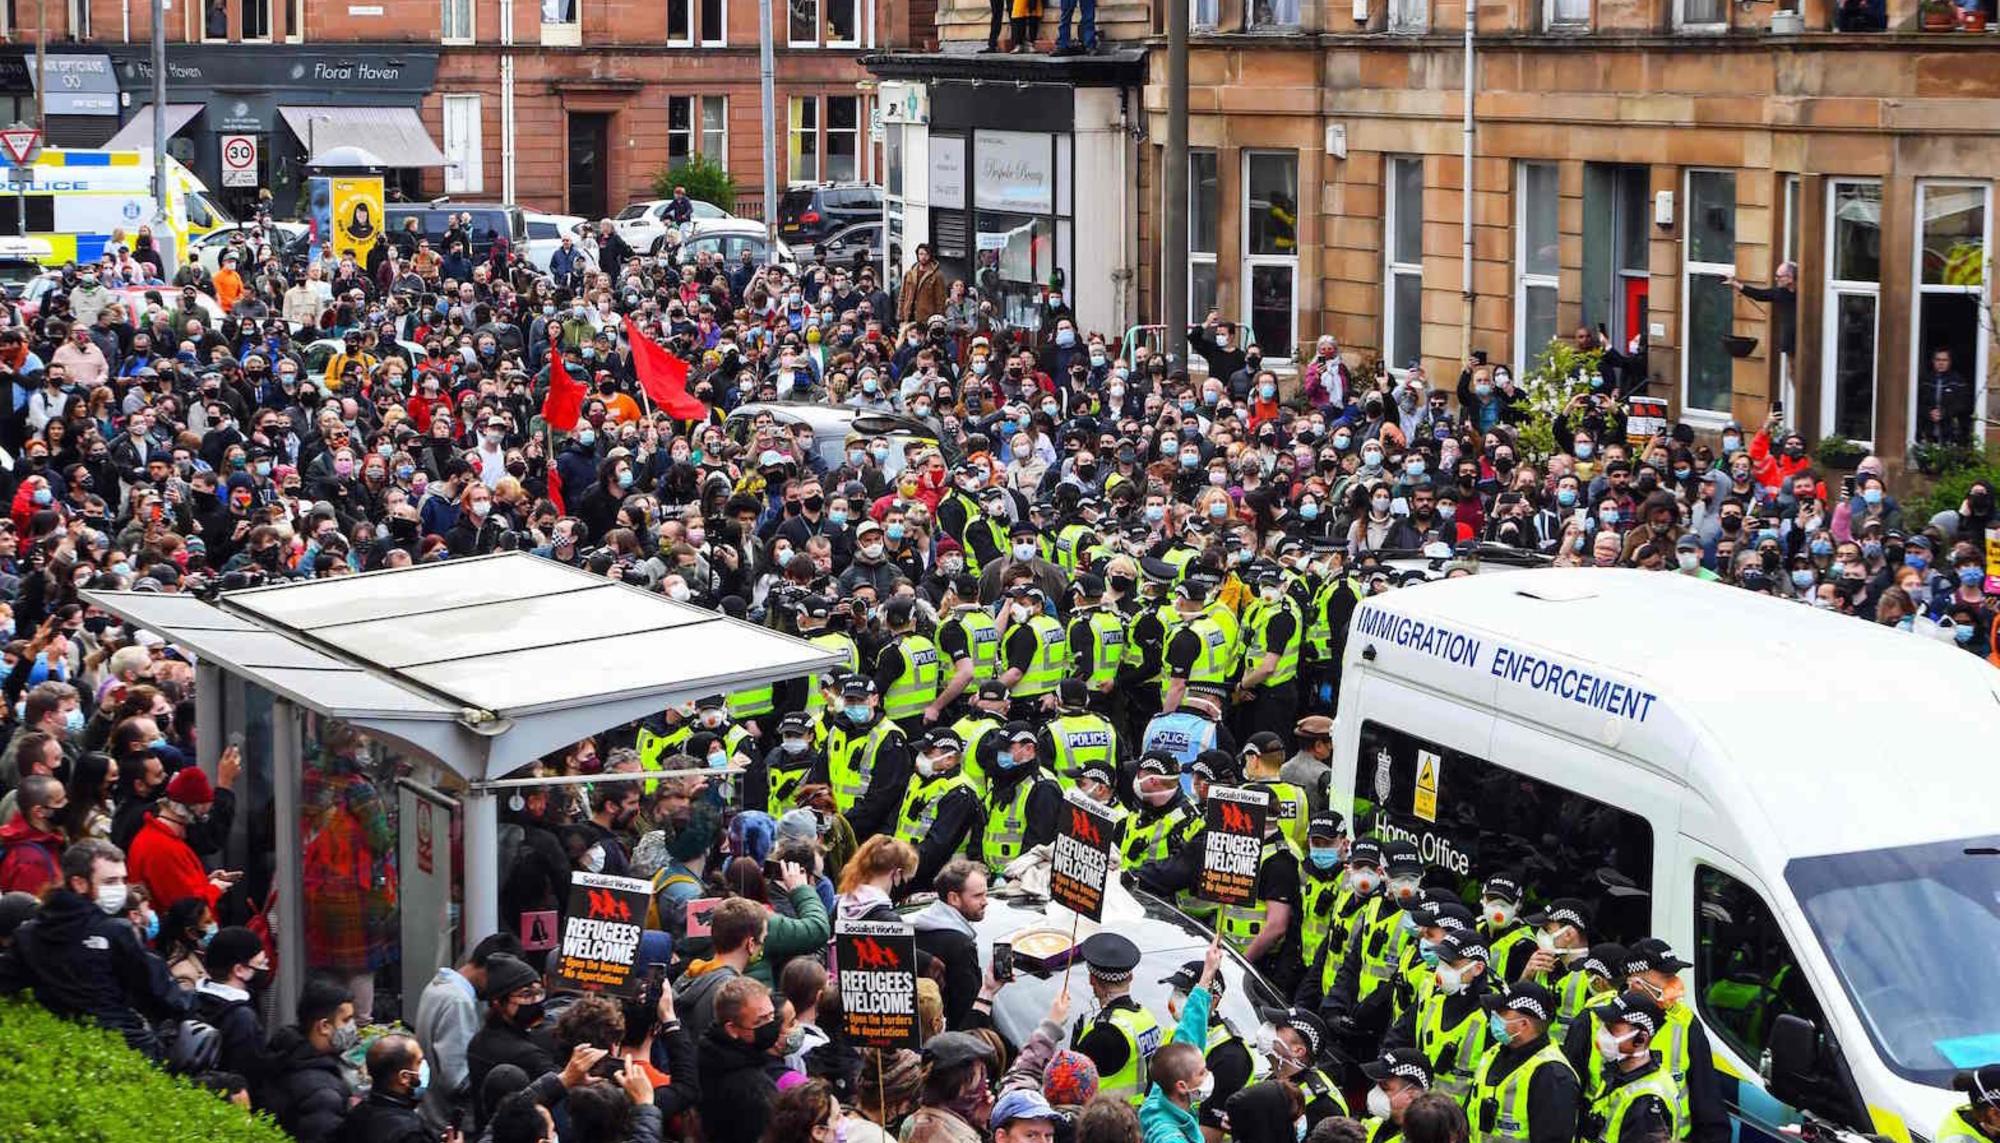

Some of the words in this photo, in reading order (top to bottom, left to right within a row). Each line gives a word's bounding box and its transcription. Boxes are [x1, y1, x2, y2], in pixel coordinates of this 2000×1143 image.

[169, 63, 202, 79] Haven
[314, 62, 351, 80] Floral
[358, 63, 399, 80] Haven
[230, 146, 250, 159] 30
[1356, 605, 1481, 669] IMMIGRATION
[1490, 647, 1657, 723] ENFORCEMENT
[1069, 733, 1111, 747] POLICE
[1152, 731, 1190, 745] POLICE
[1056, 832, 1107, 872] REFUGEES
[1207, 831, 1260, 858] REFUGEES
[1375, 812, 1419, 848] Home
[1421, 831, 1469, 876] Office
[1205, 850, 1257, 877] WELCOME
[1393, 853, 1416, 862] POLICE
[1053, 849, 1104, 892] WELCOME
[1490, 877, 1515, 889] POLICE
[567, 917, 640, 945] REFUGEES
[844, 923, 875, 933] Socialist
[875, 924, 904, 933] Worker
[562, 937, 636, 965] WELCOME
[840, 970, 914, 993] REFUGEES
[842, 991, 914, 1014] WELCOME
